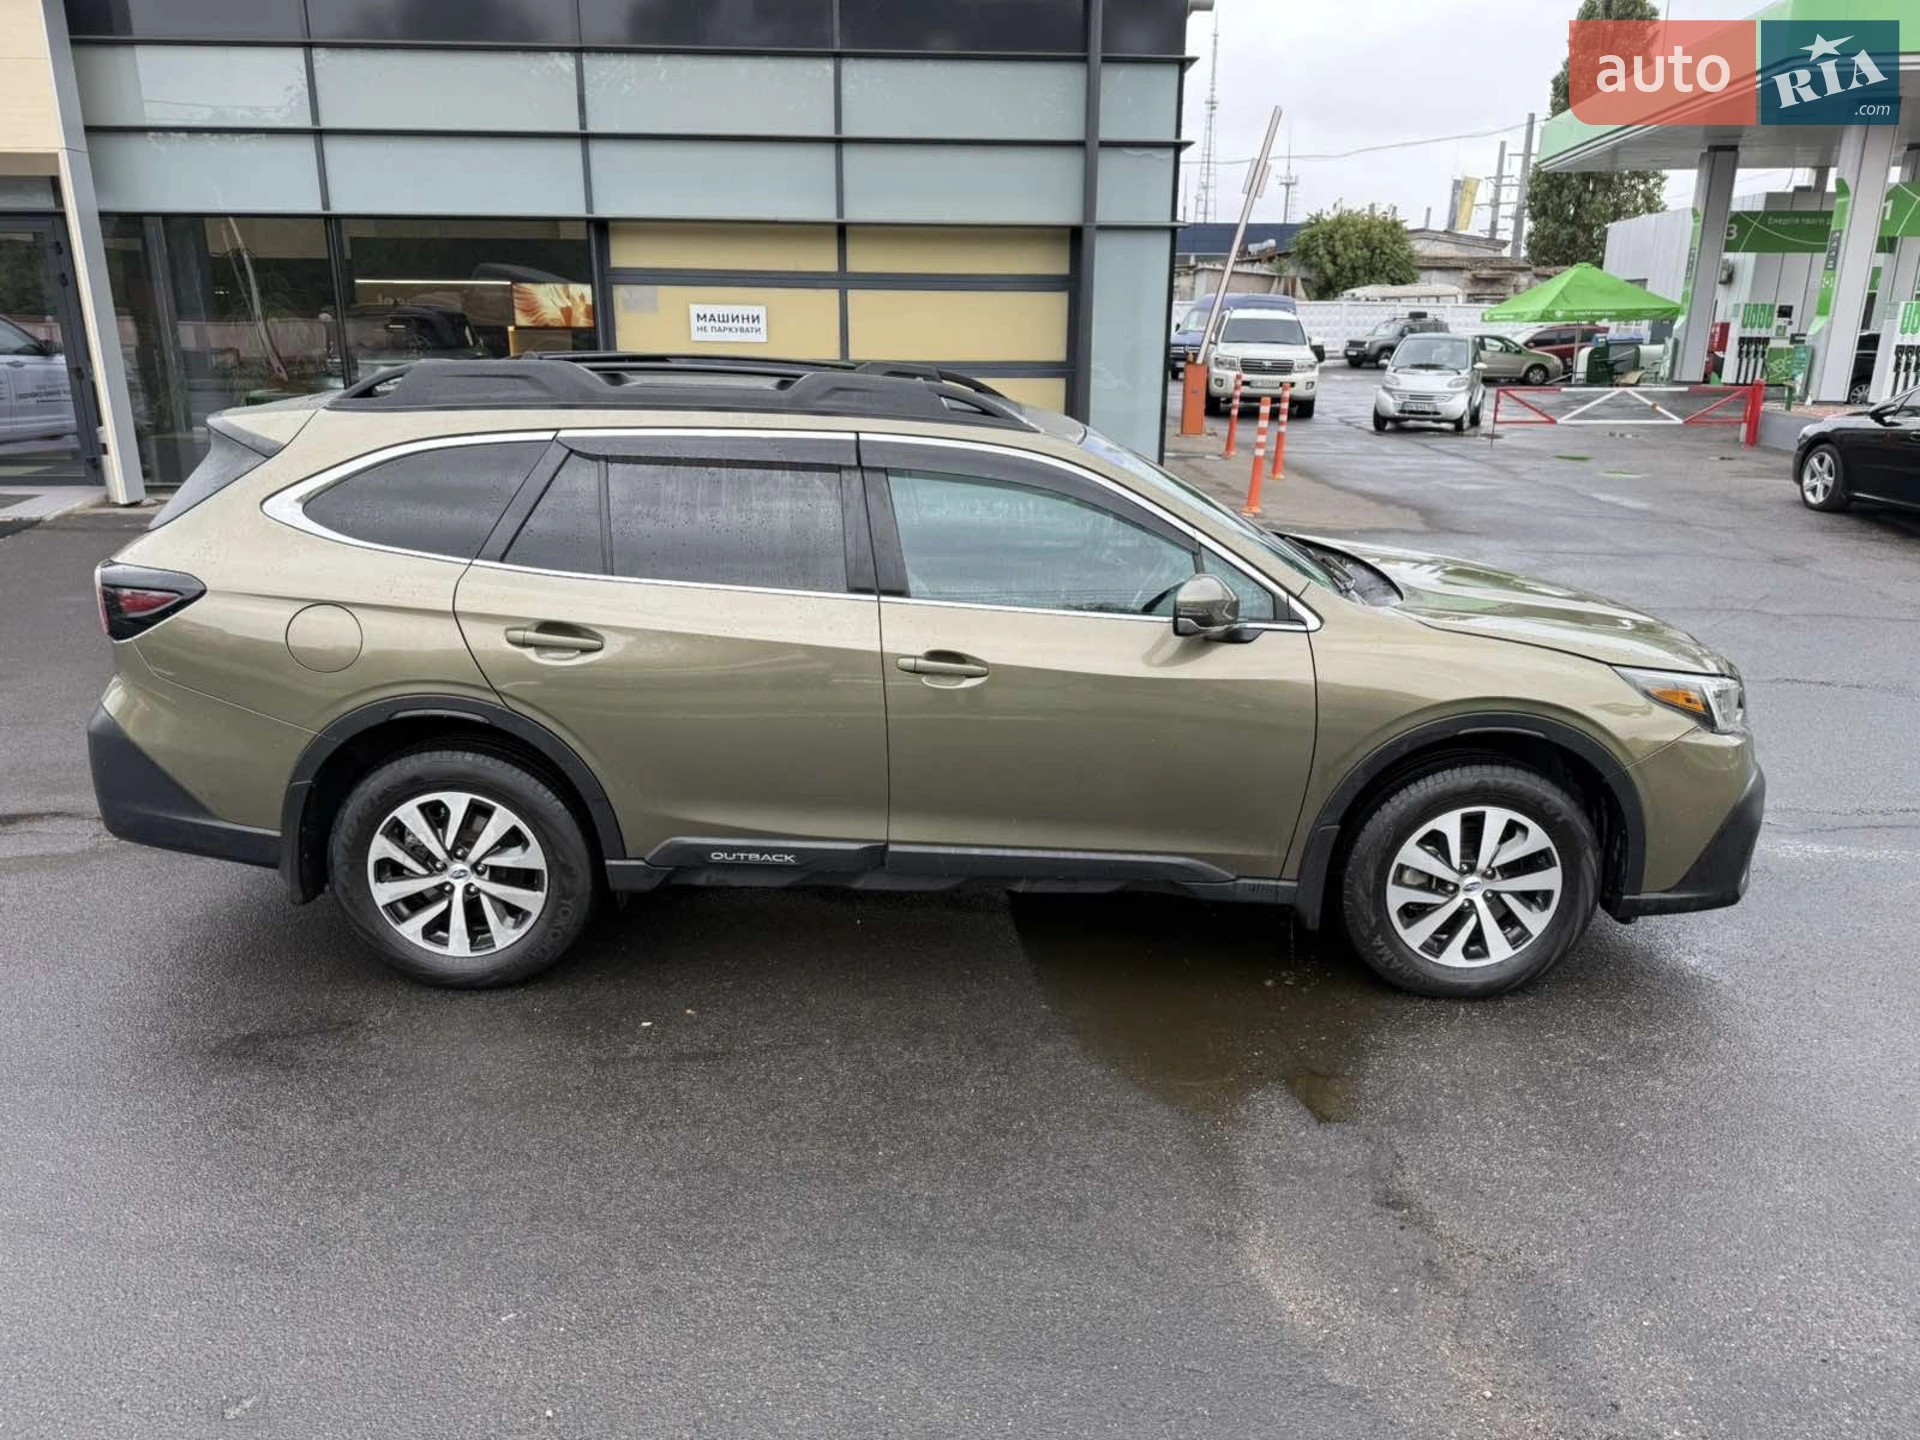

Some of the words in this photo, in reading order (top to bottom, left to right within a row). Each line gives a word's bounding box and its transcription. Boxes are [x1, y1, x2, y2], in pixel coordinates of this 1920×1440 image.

[1725, 223, 1738, 240] 3
[696, 313, 761, 324] МАШИНИ
[696, 325, 709, 333] НЕ
[710, 326, 761, 334] ПАРКУВАТИ
[710, 852, 796, 863] OUTBACK
